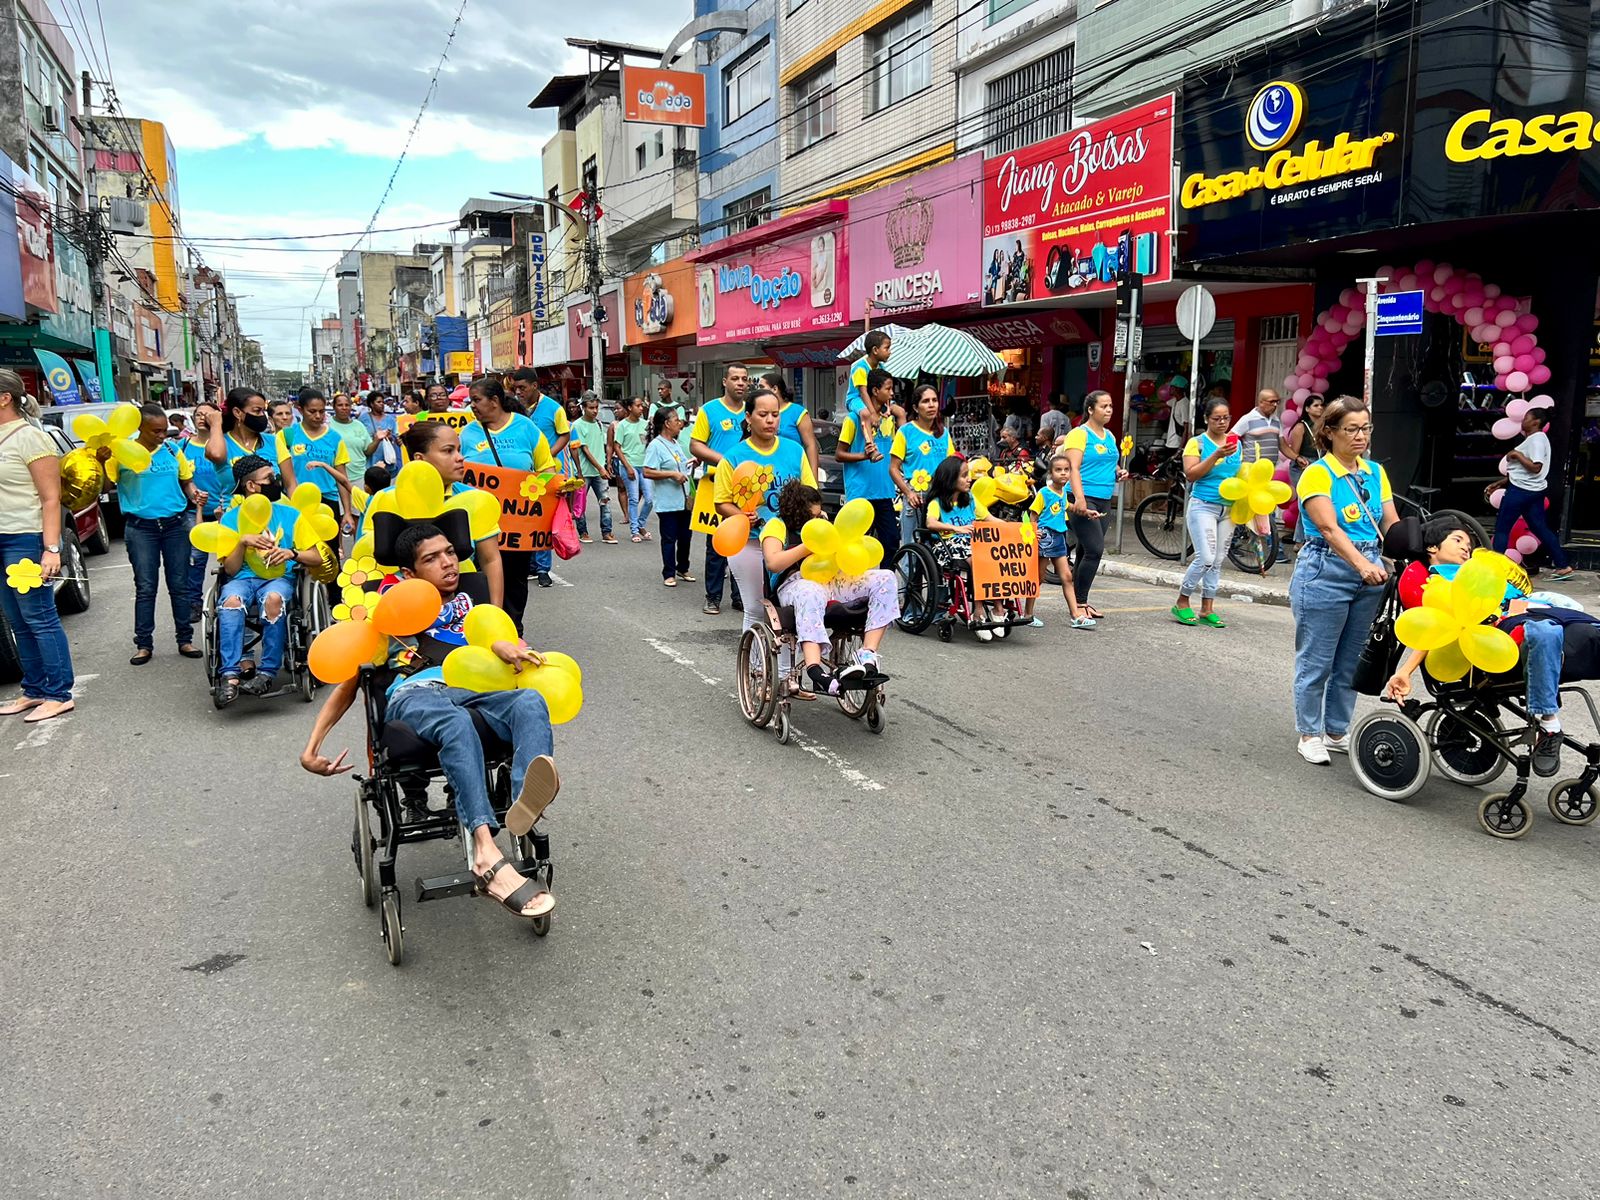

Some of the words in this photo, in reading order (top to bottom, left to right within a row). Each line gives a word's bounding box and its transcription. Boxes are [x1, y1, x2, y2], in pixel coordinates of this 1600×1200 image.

[1445, 109, 1593, 163] Casa
[997, 156, 1058, 212] Jiang
[1062, 127, 1150, 195] Bolsas
[1181, 172, 1245, 209] Casa
[1264, 132, 1384, 190] Celular
[1052, 194, 1093, 217] Atacado
[1095, 191, 1105, 206] &
[1108, 182, 1143, 203] Varejo
[1270, 195, 1277, 205] É
[1277, 189, 1309, 204] BARATO
[1310, 188, 1317, 196] E
[1317, 178, 1354, 195] SEMPRE
[1001, 213, 1036, 232] 98838-2987
[1095, 213, 1130, 230] Carregadores
[531, 234, 545, 319] DENTISTAS
[718, 263, 752, 294] Nova
[750, 265, 802, 309] Opção
[874, 269, 943, 301] PRINCESA
[1377, 296, 1397, 305] Avenida
[463, 469, 500, 490] AIO
[502, 498, 543, 517] NJA
[973, 526, 1000, 543] MEU
[991, 543, 1033, 561] CORPO
[1000, 562, 1027, 577] MEU
[982, 580, 1037, 598] TESOURO
